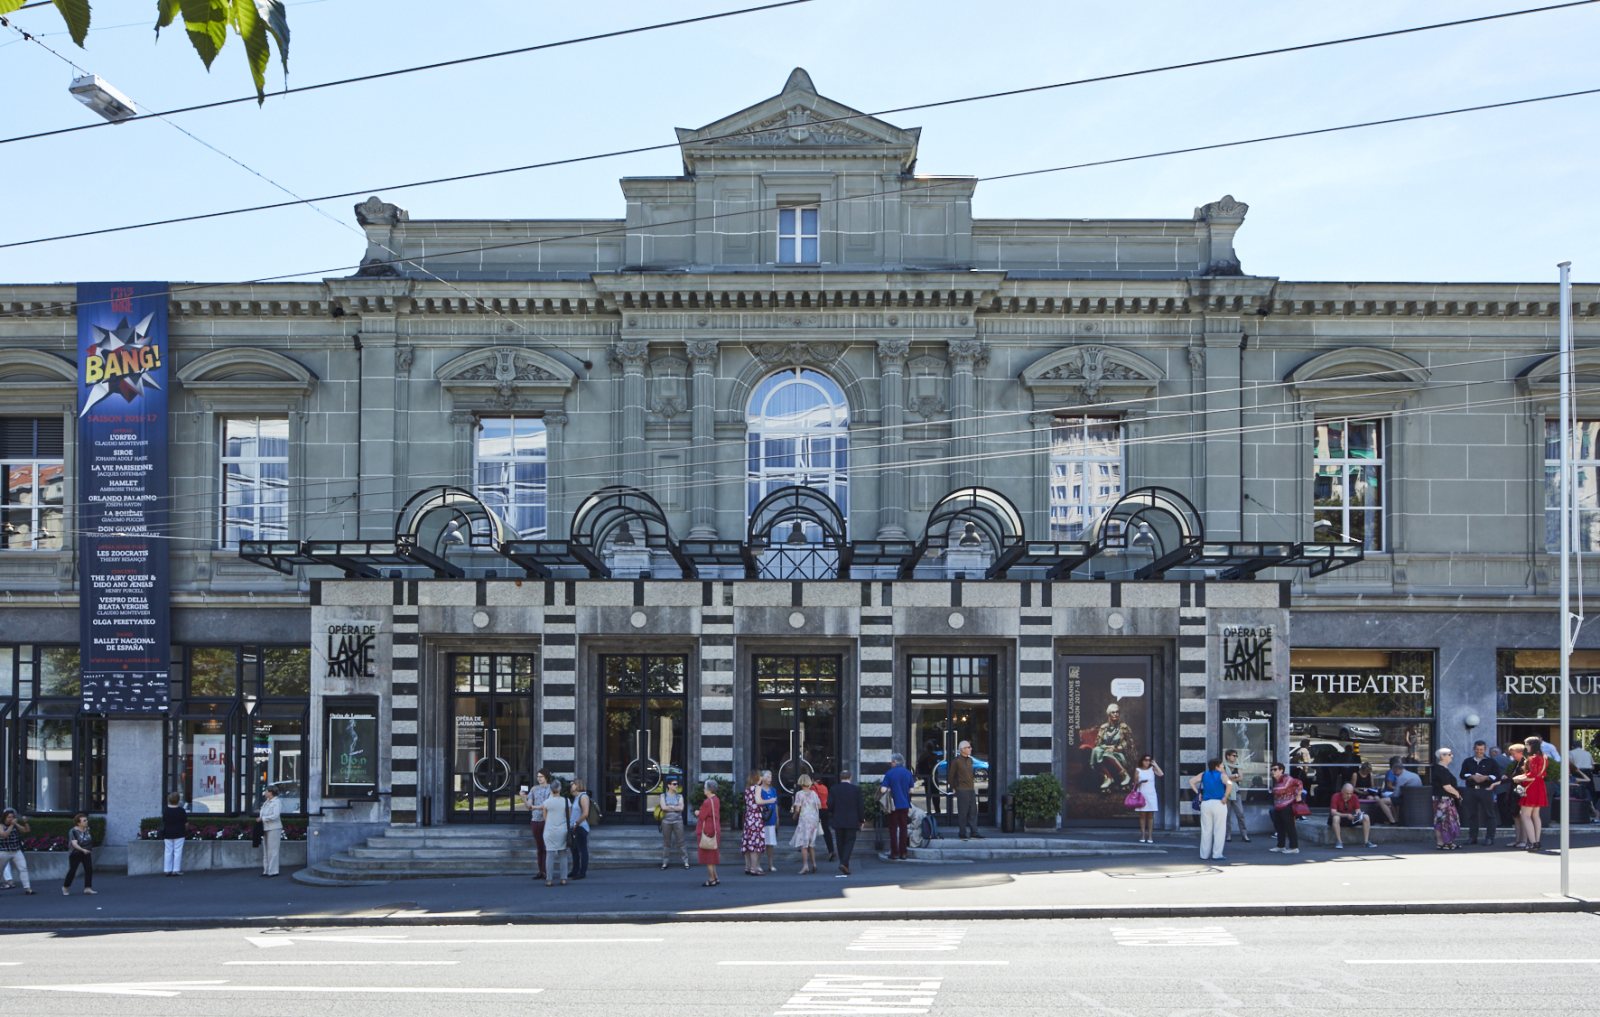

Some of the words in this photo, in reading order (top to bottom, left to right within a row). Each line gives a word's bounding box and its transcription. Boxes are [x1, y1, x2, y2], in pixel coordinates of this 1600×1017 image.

[86, 345, 161, 384] BANG!
[328, 624, 360, 634] OPÉRA
[363, 625, 376, 634] DE
[1224, 626, 1256, 637] OPÉRA
[1260, 628, 1272, 637] DE
[1312, 674, 1426, 694] THEATRE
